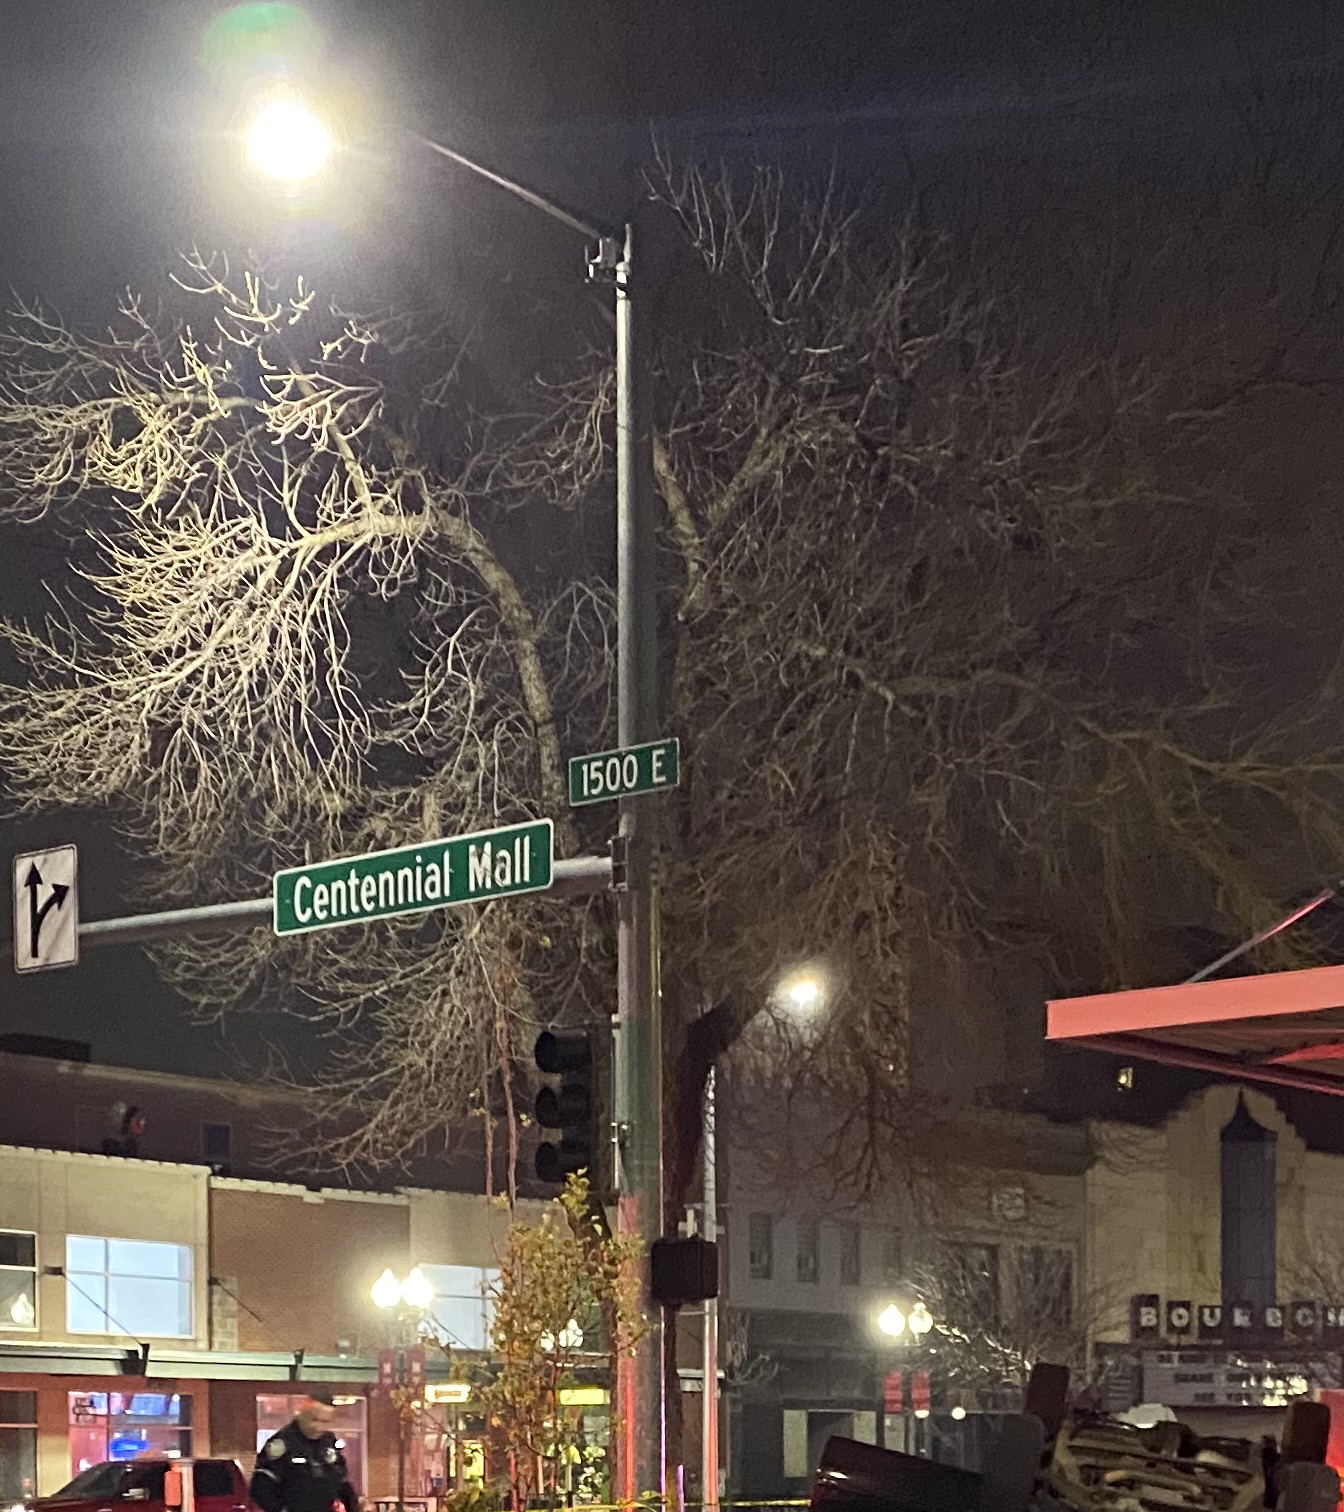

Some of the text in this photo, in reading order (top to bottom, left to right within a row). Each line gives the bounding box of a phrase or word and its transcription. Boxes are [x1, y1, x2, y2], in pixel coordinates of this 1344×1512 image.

[582, 748, 667, 797] 1500 E
[293, 834, 531, 924] Centennial Mall
